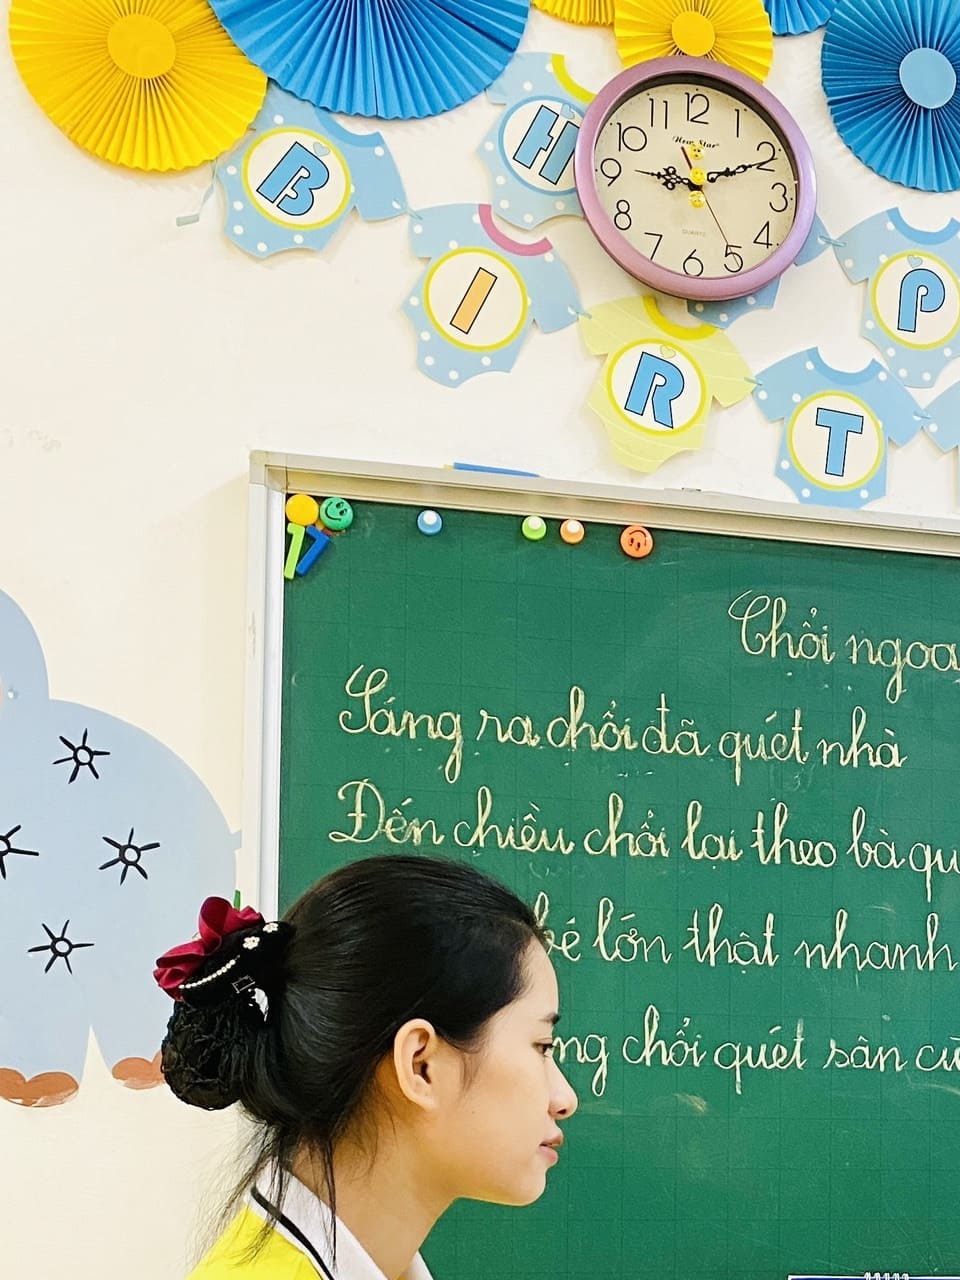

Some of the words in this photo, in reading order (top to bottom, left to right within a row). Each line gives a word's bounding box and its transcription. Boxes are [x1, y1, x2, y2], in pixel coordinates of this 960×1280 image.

[649, 97, 668, 130] 11
[685, 92, 710, 125] 12
[735, 108, 741, 138] 1
[617, 122, 648, 152] 10
[756, 141, 777, 172] 2
[600, 157, 622, 187] 9
[769, 182, 788, 212] 3
[614, 200, 632, 230] 8
[644, 232, 663, 261] 7
[753, 220, 773, 249] 4
[683, 249, 704, 277] 6
[724, 244, 743, 273] 5
[728, 590, 836, 664] Chổi
[339, 665, 462, 783] Sáng
[477, 709, 541, 747] ra
[547, 686, 638, 752] chổi
[642, 693, 711, 756] đã
[719, 708, 809, 786] quét
[818, 706, 908, 768] nhà
[328, 778, 444, 846] Đến
[454, 786, 575, 853] chiều
[583, 792, 670, 857] chổi
[751, 802, 837, 867] theo
[847, 806, 905, 869] bà
[593, 897, 672, 964] lớn
[683, 903, 780, 975] thật
[794, 908, 959, 971] nhanh
[622, 1004, 706, 1067] chổi
[714, 1019, 807, 1095] quét
[823, 1035, 907, 1072] sân
